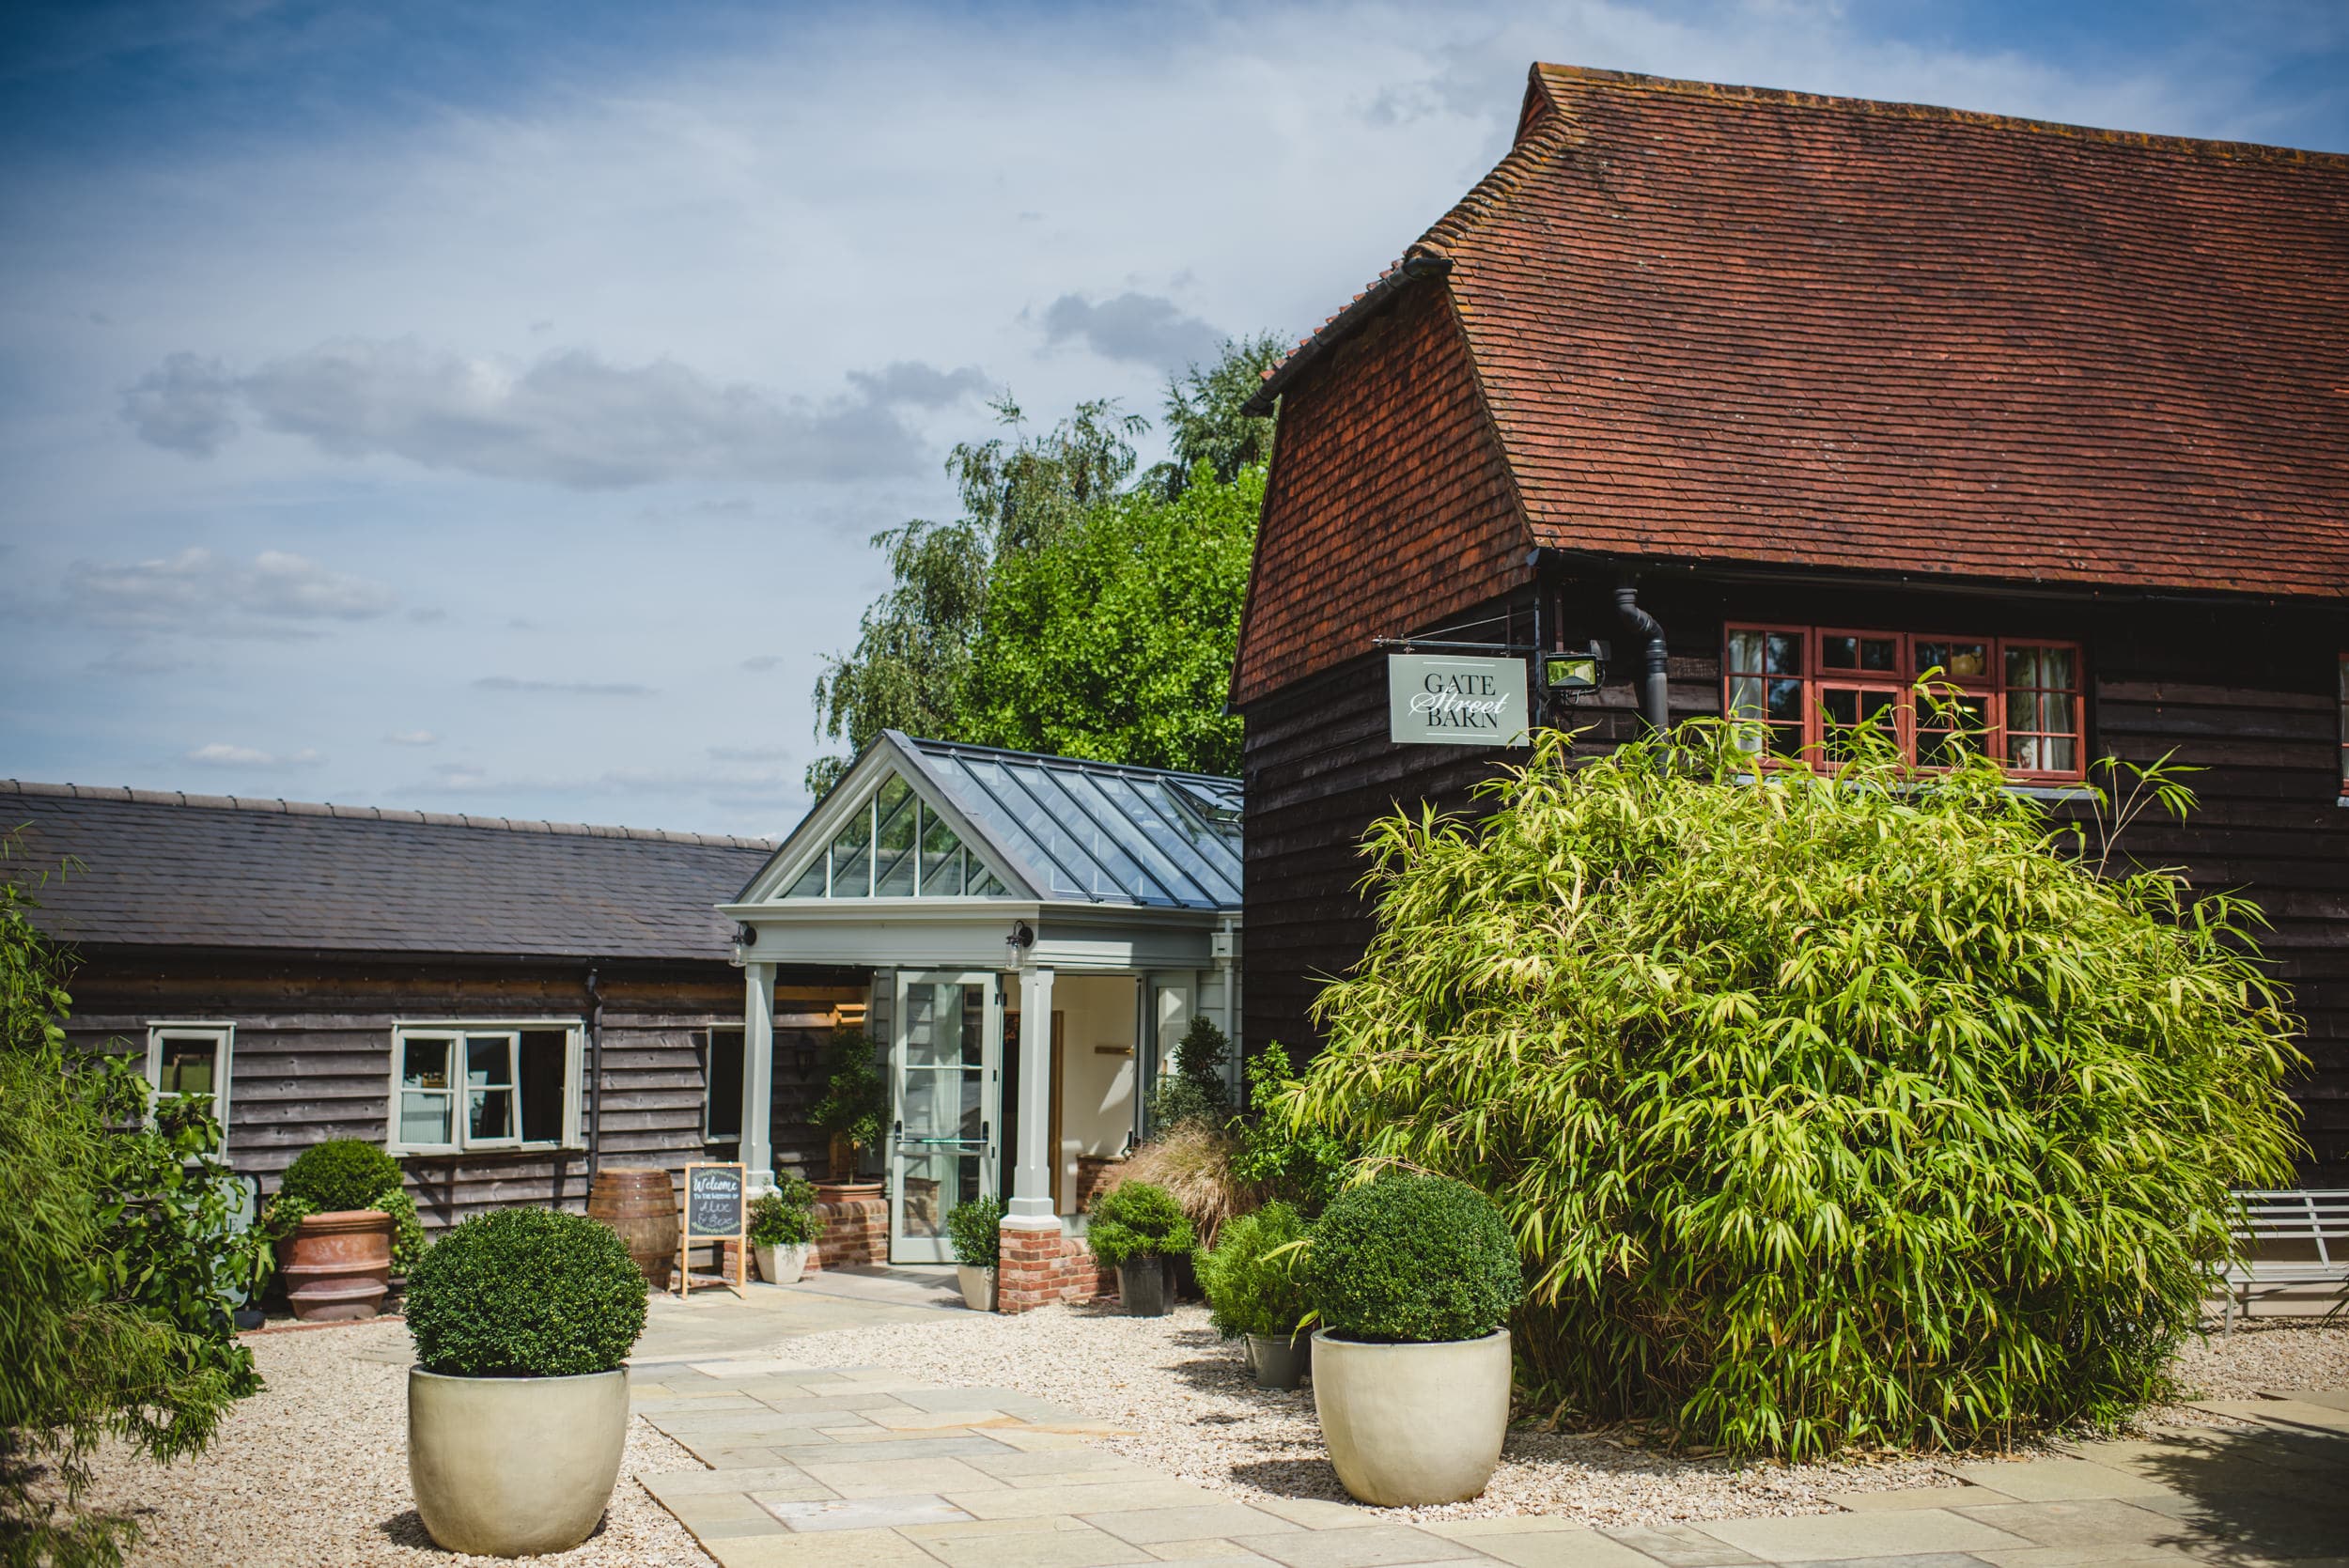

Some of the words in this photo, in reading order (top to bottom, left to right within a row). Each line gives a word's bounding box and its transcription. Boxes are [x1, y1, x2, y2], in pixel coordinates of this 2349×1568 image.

[1424, 673, 1496, 696] GATE
[1408, 682, 1510, 717] Street
[1425, 706, 1499, 729] BARN
[693, 1176, 738, 1192] Welcome
